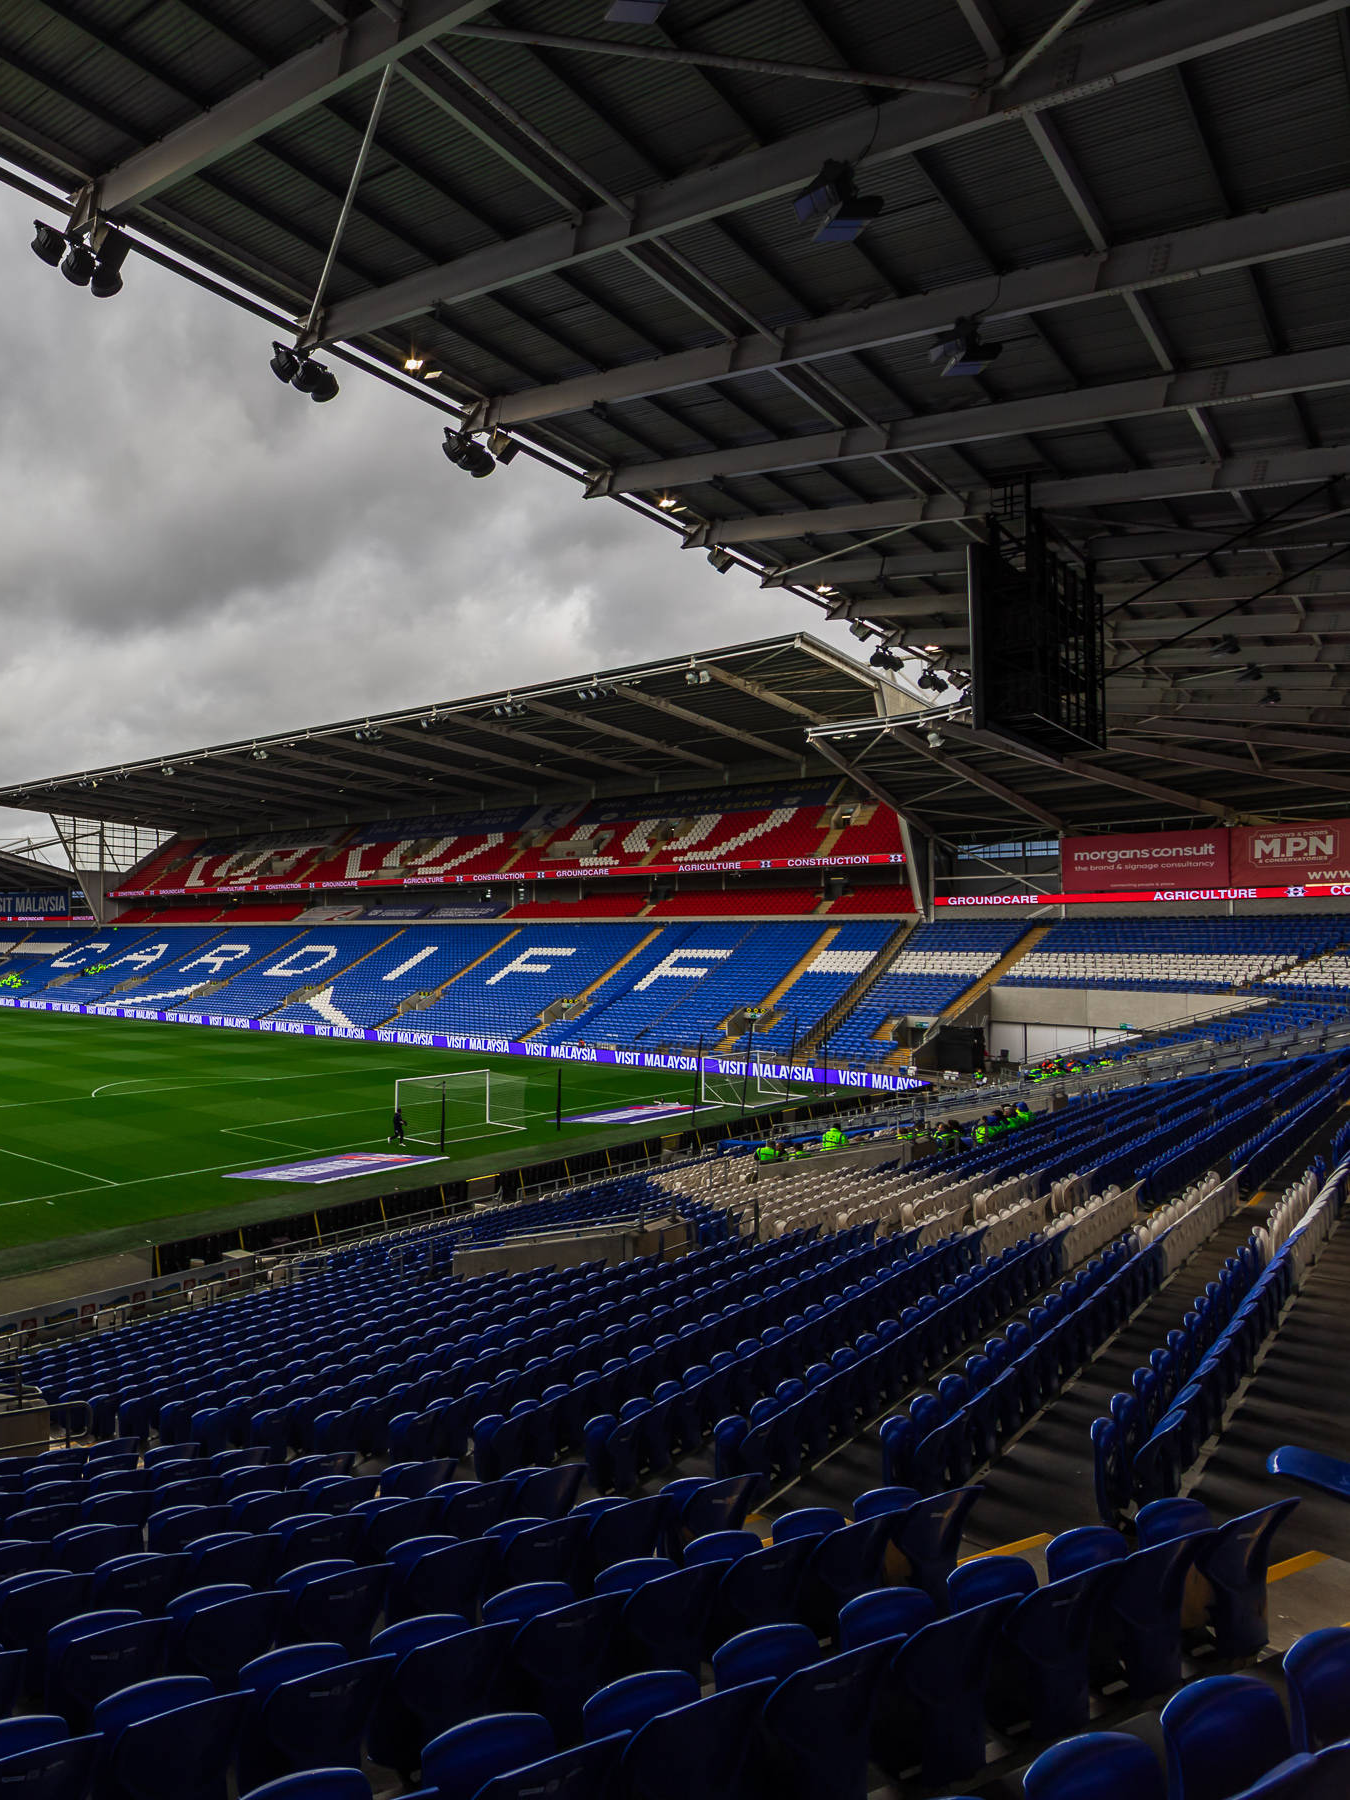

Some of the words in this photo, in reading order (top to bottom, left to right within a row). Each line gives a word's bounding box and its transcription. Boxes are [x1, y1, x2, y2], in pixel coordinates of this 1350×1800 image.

[1254, 835, 1334, 859] M.P.N
[678, 862, 741, 872] AGRICULTURE
[787, 855, 869, 867] CONSTRUCTION
[1090, 863, 1115, 872] brand
[1124, 862, 1159, 871] signage
[1160, 860, 1215, 870] consultancy
[1264, 855, 1328, 864] CONSERVATORIES
[321, 880, 358, 888] GROUNDCARE
[403, 876, 444, 884] AGRICULTURE
[473, 872, 525, 881] CONSTRUCTION
[556, 868, 609, 878] GROUNDCARE
[948, 895, 1039, 905] GROUNDCARE
[1153, 888, 1257, 901] AGRICULTURE
[15, 896, 66, 913] MALAYSIA
[51, 943, 734, 992] CARDIFF
[124, 1008, 134, 1017] VISIT
[136, 1008, 158, 1020] MALAYSIA
[165, 1011, 177, 1022] VISIT
[178, 1012, 202, 1024] MALAYSIA
[209, 1015, 222, 1026] VISIT
[224, 1016, 250, 1029] MALAYSIA
[259, 1020, 273, 1031] VISIT
[275, 1021, 304, 1034] MALAYSIA
[315, 1025, 330, 1036] VISIT
[332, 1026, 365, 1039] MALAYSIA
[377, 1030, 394, 1042] VISIT
[397, 1031, 433, 1046] MALAYSIA
[447, 1036, 466, 1049] VISIT
[469, 1037, 509, 1053] MALAYSIA
[525, 1042, 547, 1057] VISIT
[550, 1044, 597, 1061] MALAYSIA
[614, 1050, 640, 1066] VISIT
[644, 1053, 697, 1071] MALAYSIA
[718, 1059, 748, 1076] VISIT
[752, 1062, 814, 1082] MALAYSIA
[838, 1069, 868, 1087] VISIT
[871, 1072, 923, 1091] MALAYSIA
